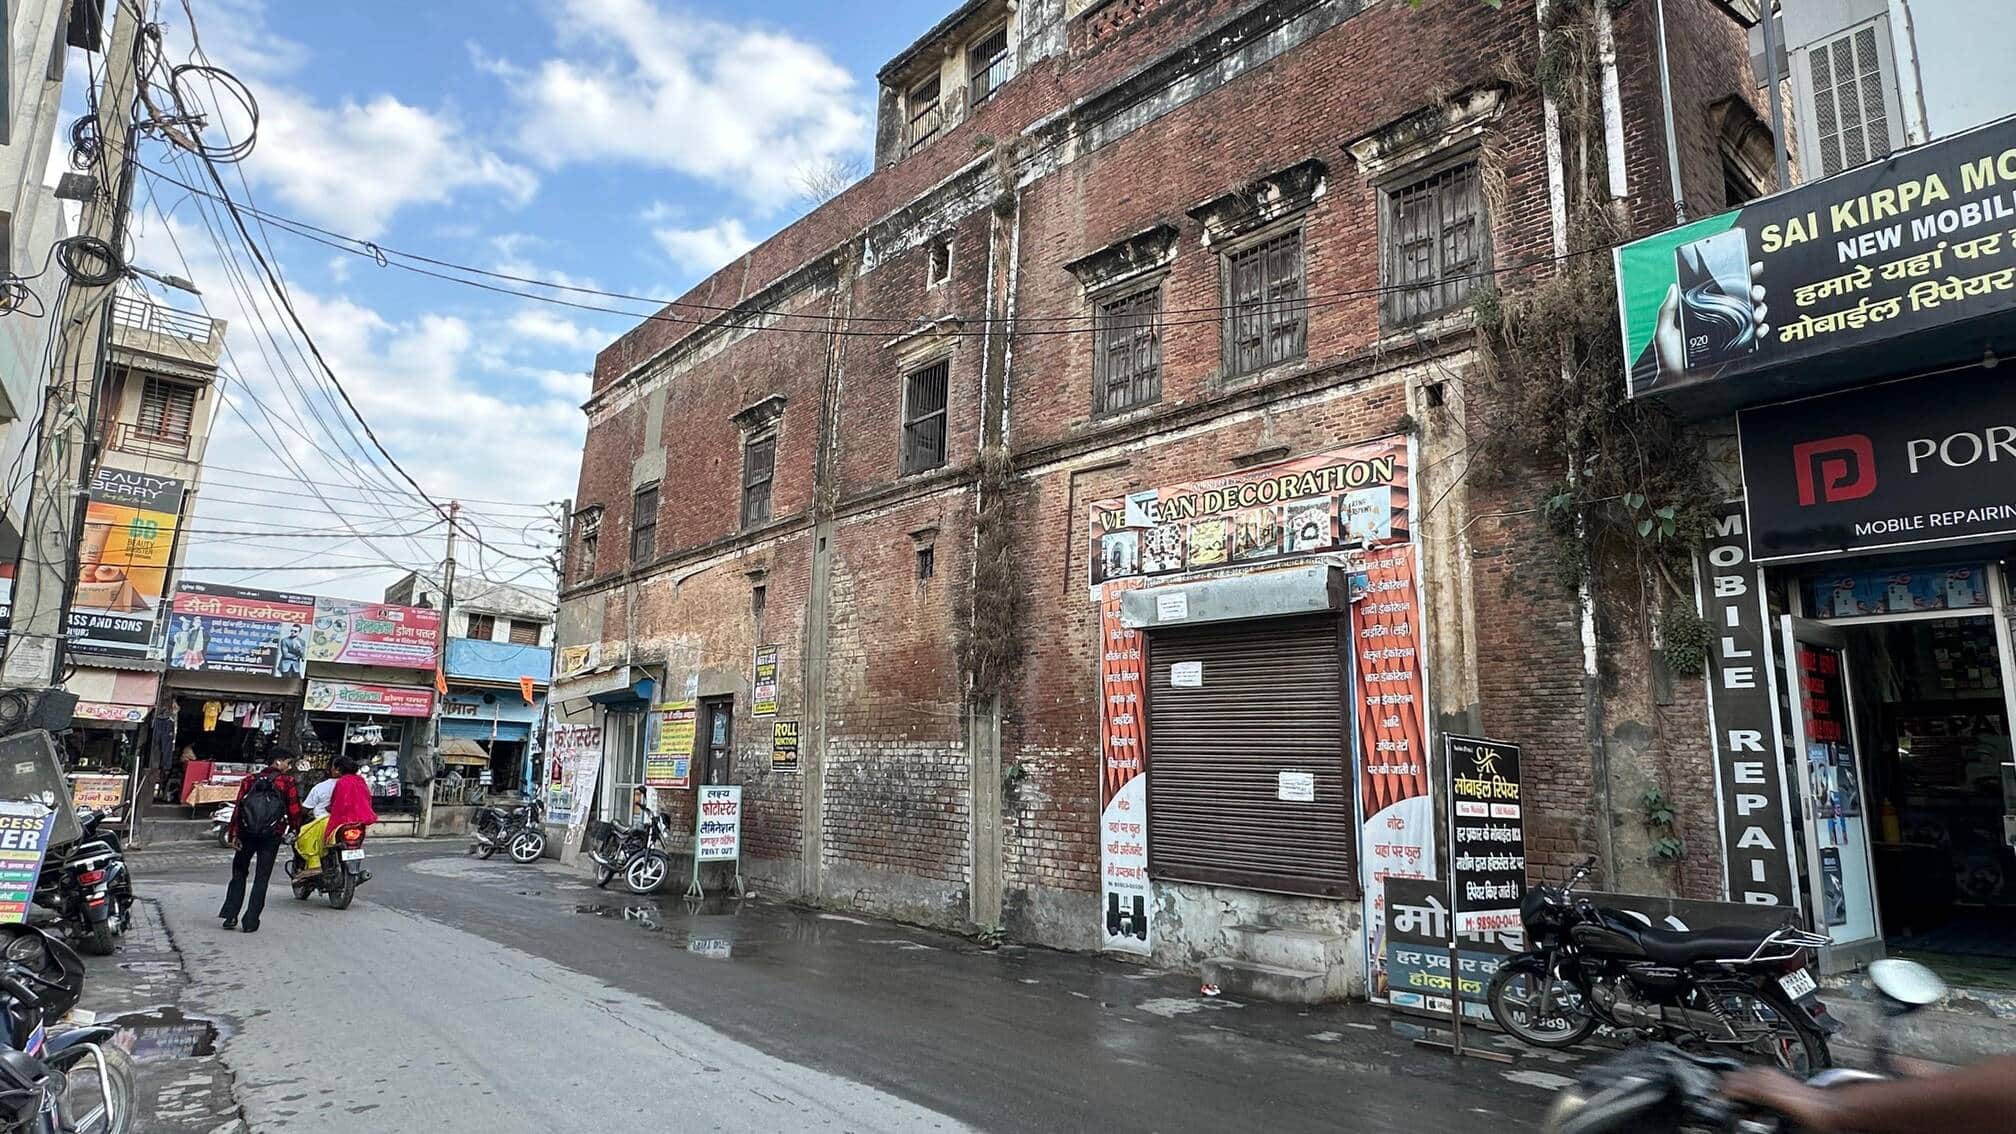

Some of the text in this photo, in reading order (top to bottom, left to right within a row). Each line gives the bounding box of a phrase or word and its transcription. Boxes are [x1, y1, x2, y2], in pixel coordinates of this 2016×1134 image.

[1761, 217, 1818, 253] SAI
[1830, 173, 1950, 233] KIRPA
[1837, 190, 2016, 263] NEW MOBIL
[1794, 233, 2002, 308] हमारे यहां पर
[1778, 268, 2015, 344] मोबाईल रिपेयर
[1203, 455, 1396, 518] DECORATION
[1855, 515, 1925, 536] MOBILE
[89, 616, 113, 629] AND
[114, 619, 143, 632] SONS
[184, 596, 221, 614] सैनी
[1705, 514, 1757, 690] MOBILE
[774, 723, 797, 737] ROLL
[1396, 950, 1421, 965] हर
